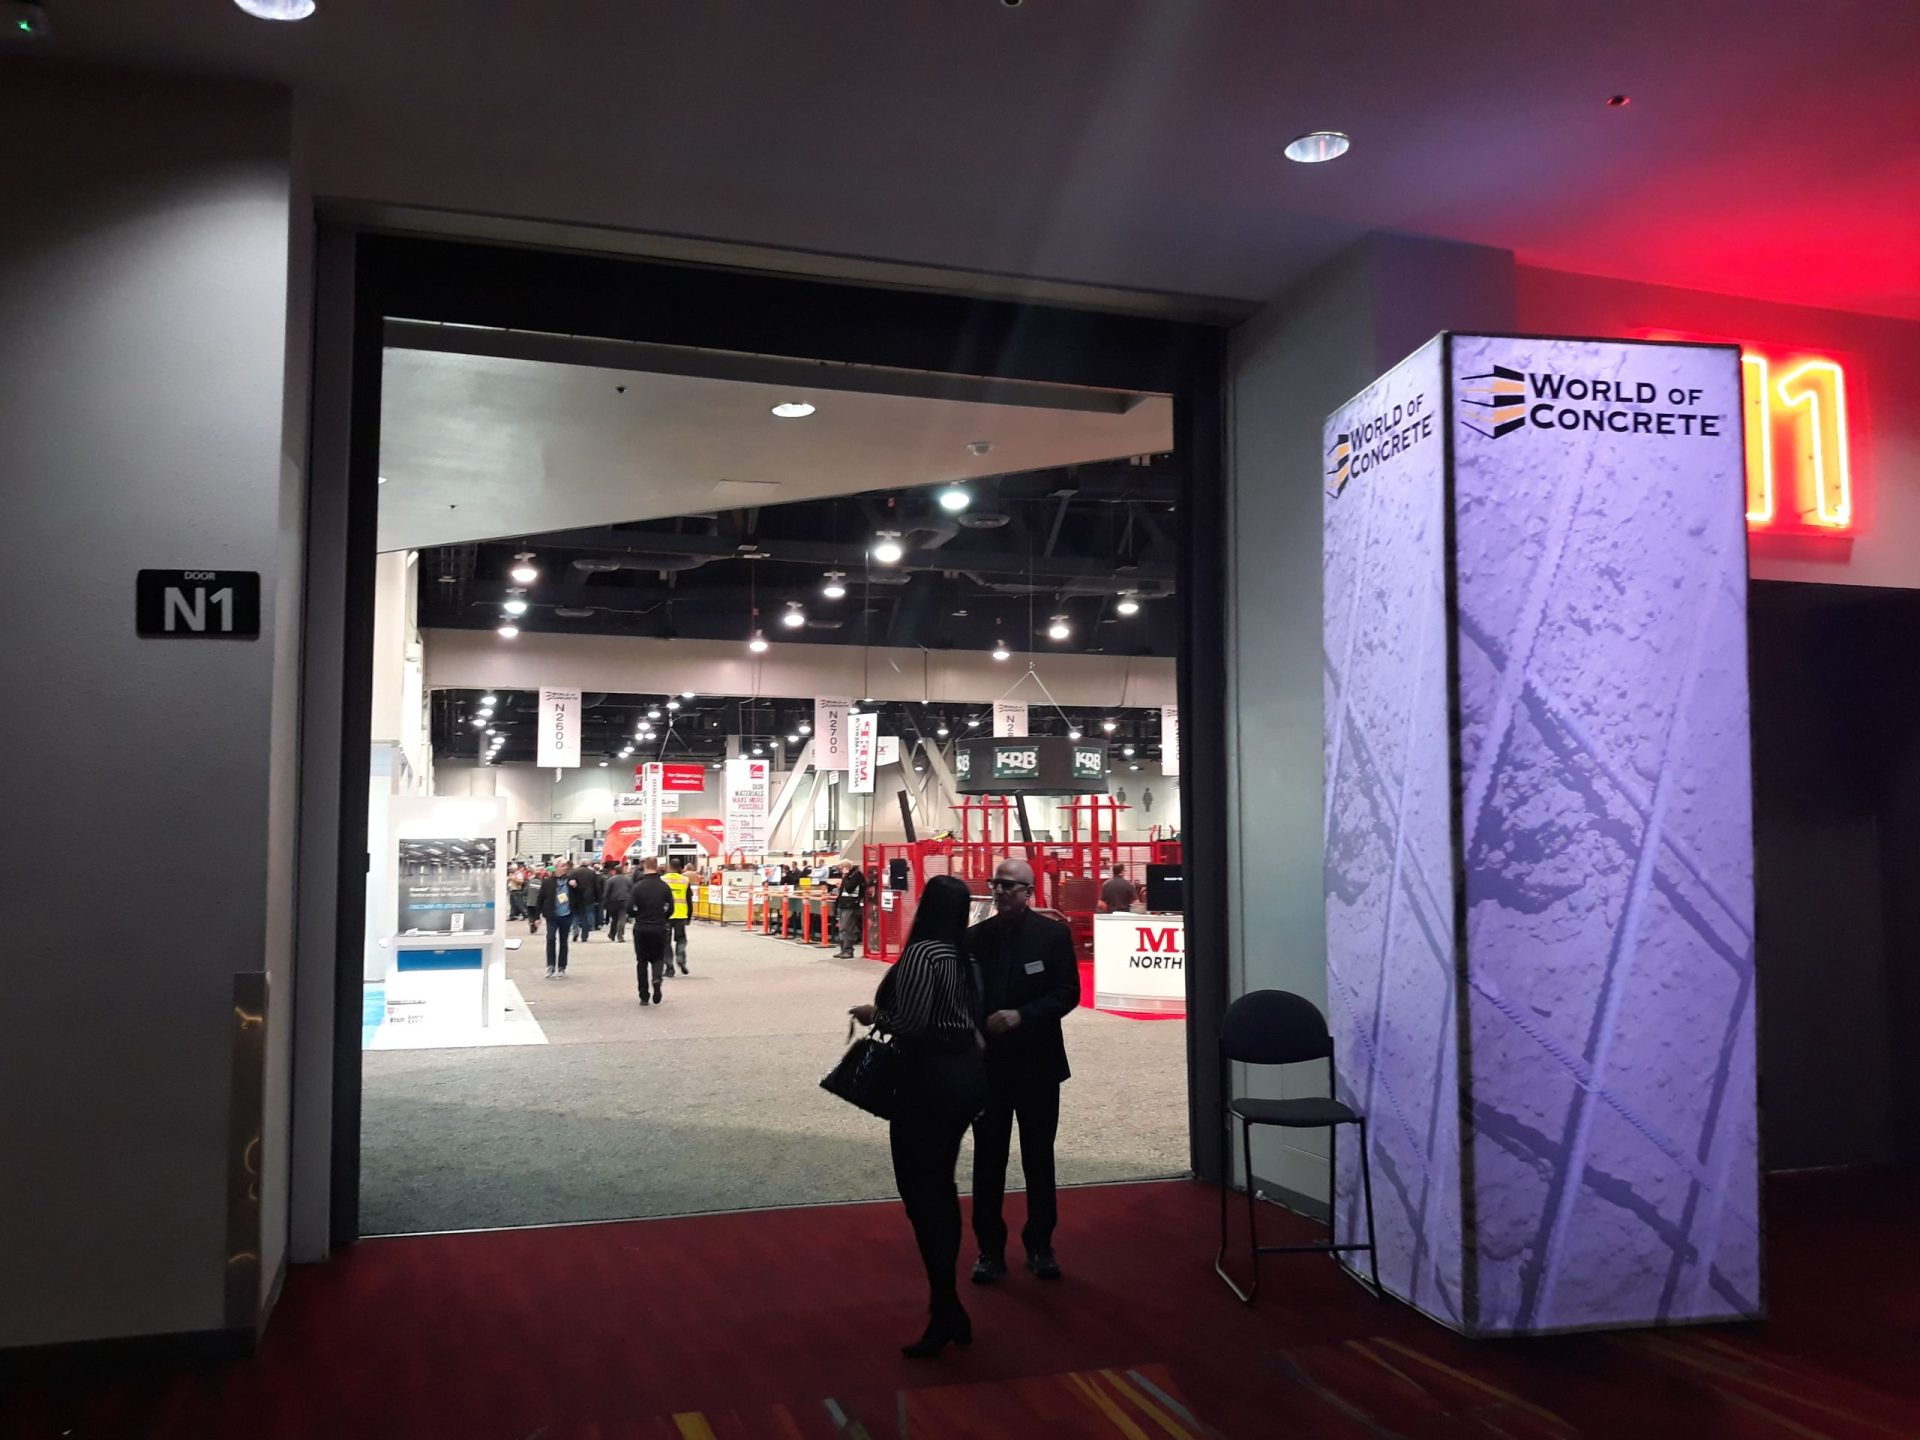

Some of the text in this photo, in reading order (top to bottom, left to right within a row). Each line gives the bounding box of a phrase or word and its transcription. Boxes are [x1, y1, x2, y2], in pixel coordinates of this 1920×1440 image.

[1529, 373, 1703, 405] WORLD OF
[1350, 393, 1424, 452] WORLD OF
[1530, 403, 1720, 436] CONCRETE
[1350, 414, 1432, 479] CONCRETE
[184, 571, 216, 581] DOOR
[164, 586, 233, 632] N1
[555, 703, 565, 750] N2600
[829, 711, 838, 754] N2700
[996, 752, 1037, 769] KRB
[1075, 752, 1101, 771] KRB
[1135, 927, 1185, 953] M
[1129, 956, 1183, 969] NORTH
